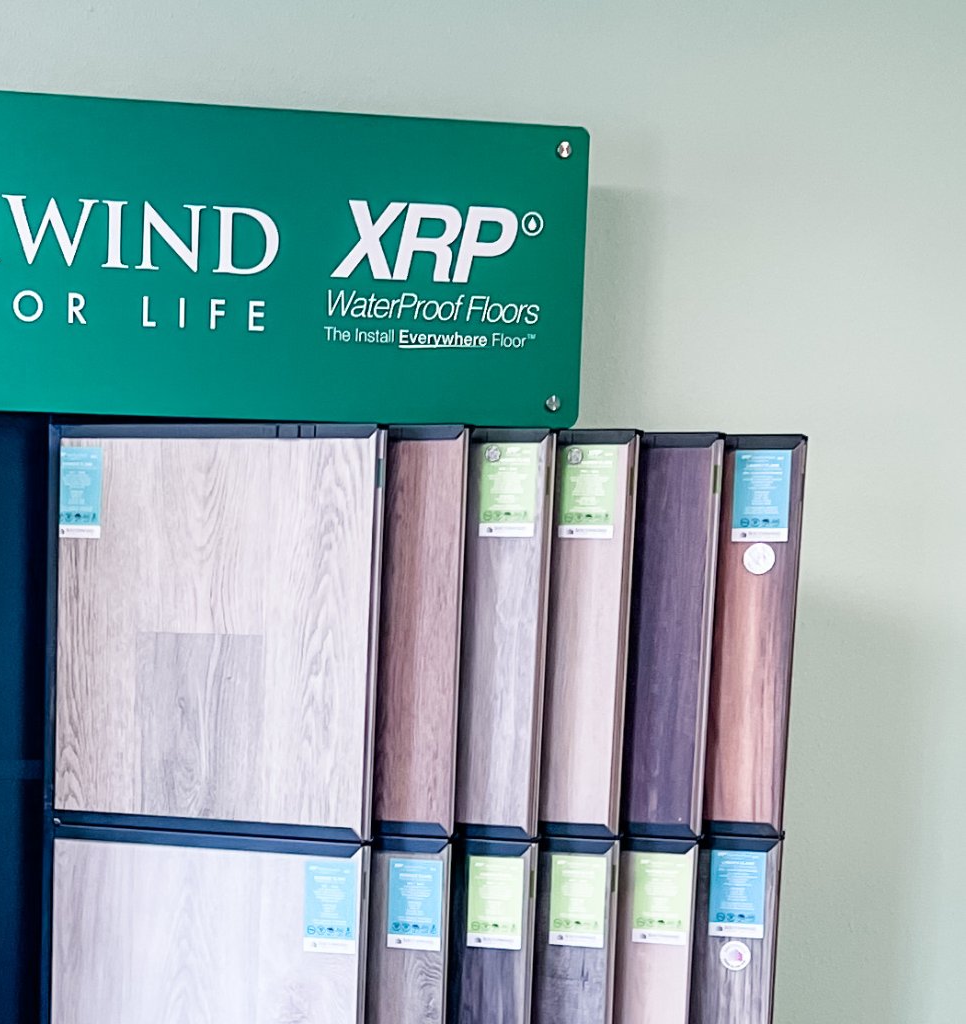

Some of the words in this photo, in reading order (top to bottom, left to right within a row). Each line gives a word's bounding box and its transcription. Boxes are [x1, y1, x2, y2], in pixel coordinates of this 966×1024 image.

[331, 199, 519, 283] XRP
[142, 295, 265, 332] LIFE
[327, 289, 465, 321] WaterProof
[466, 295, 540, 325] Floors
[323, 326, 351, 342] The
[354, 328, 395, 344] Install
[398, 329, 488, 349] Everywhere
